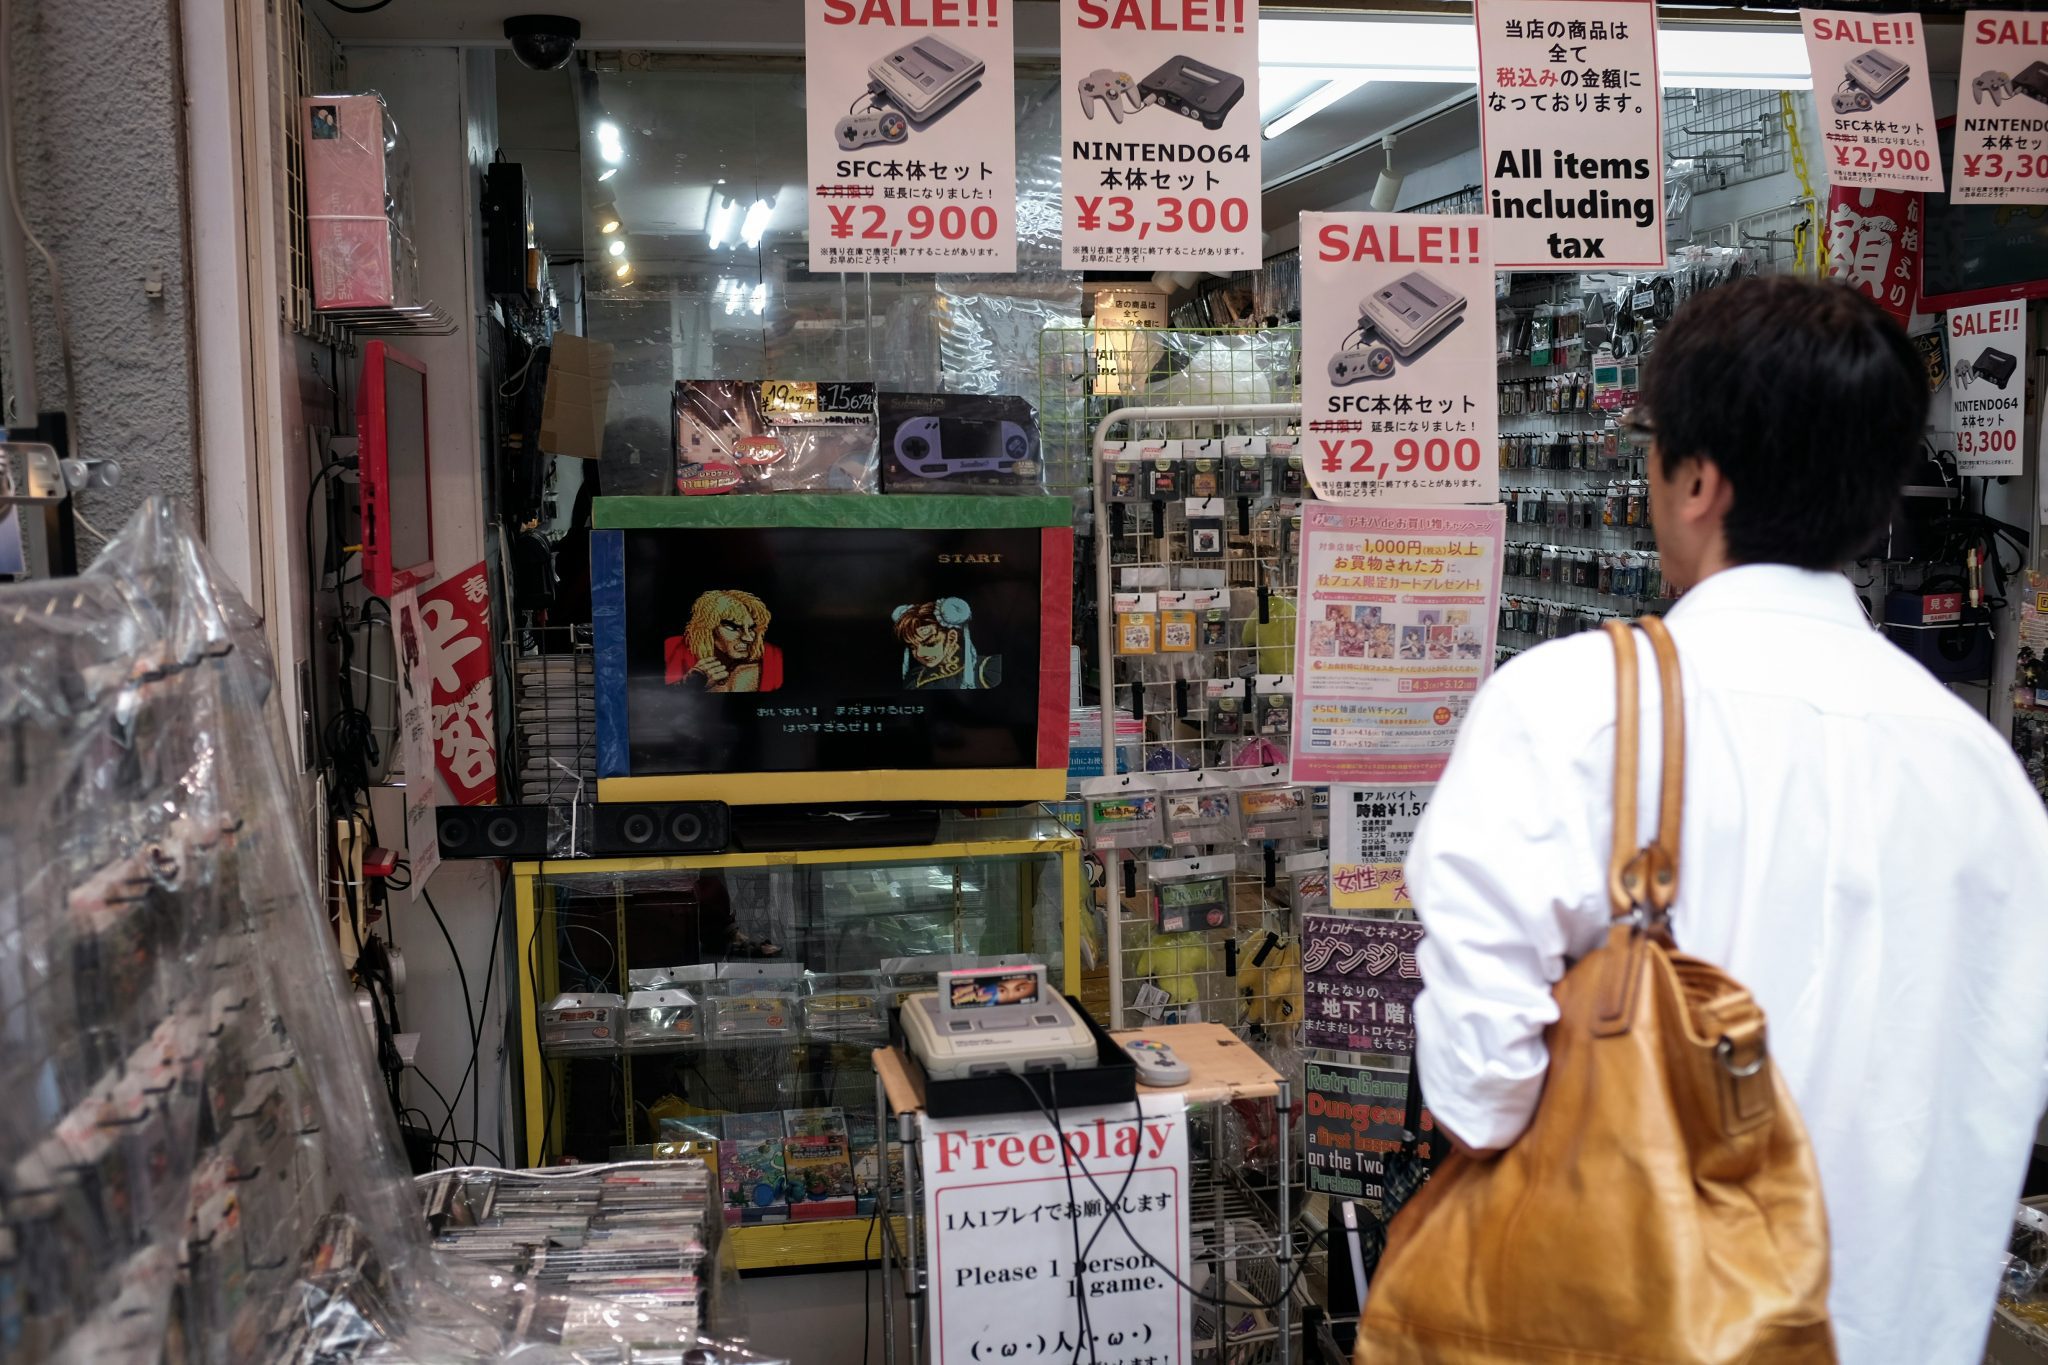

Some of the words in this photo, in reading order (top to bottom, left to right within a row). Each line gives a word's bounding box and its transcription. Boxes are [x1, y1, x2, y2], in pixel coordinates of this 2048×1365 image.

[822, 0, 999, 28] SALE!!
[1076, 0, 1244, 34] SALE!!
[1504, 20, 1628, 40] 当店の商品は
[1812, 17, 1915, 44] SALE!!
[1548, 43, 1588, 63] 全て
[1496, 67, 1641, 89] 税込みの金額に
[1488, 92, 1642, 114] なっております。
[1835, 120, 1924, 134] SFC本体セット
[1073, 142, 1250, 163] NINTENDO64
[1494, 149, 1542, 179] All
[1555, 151, 1650, 180] items
[1834, 145, 1929, 172] ¥2,900
[836, 160, 992, 181] SFC本体セット
[1100, 168, 1220, 190] 本体セット
[884, 187, 992, 199] 延長になりました！
[1074, 196, 1248, 240] ¥3,300
[1492, 190, 1654, 227] including
[828, 205, 998, 247] ¥2,900
[1318, 224, 1479, 264] SALE!!
[1548, 232, 1605, 259] tax
[1828, 188, 1898, 299] 額
[1116, 300, 1156, 308] 店の商品は
[1952, 308, 2019, 337] SALE!!
[1328, 394, 1475, 414] SFC本体セット
[1954, 398, 2018, 412] NINTENDO64
[1372, 421, 1475, 432] 延長になりました！
[1957, 430, 2016, 456] ¥3,300
[1319, 438, 1480, 480] ¥2,900
[938, 554, 1001, 563] START
[1365, 790, 1416, 802] アルバイト
[1307, 1092, 1434, 1132] Dungeos
[934, 1118, 1175, 1174] Freeplay
[1309, 1133, 1316, 1144] a
[1308, 1152, 1324, 1168] on
[1329, 1150, 1351, 1170] the
[1355, 1152, 1384, 1174] Two
[1310, 1166, 1362, 1196] Purchase
[1366, 1183, 1384, 1198] an
[956, 1265, 1038, 1286] Please
[1049, 1260, 1061, 1278] 1
[1072, 1254, 1156, 1277] person
[1090, 1276, 1164, 1297] game.
